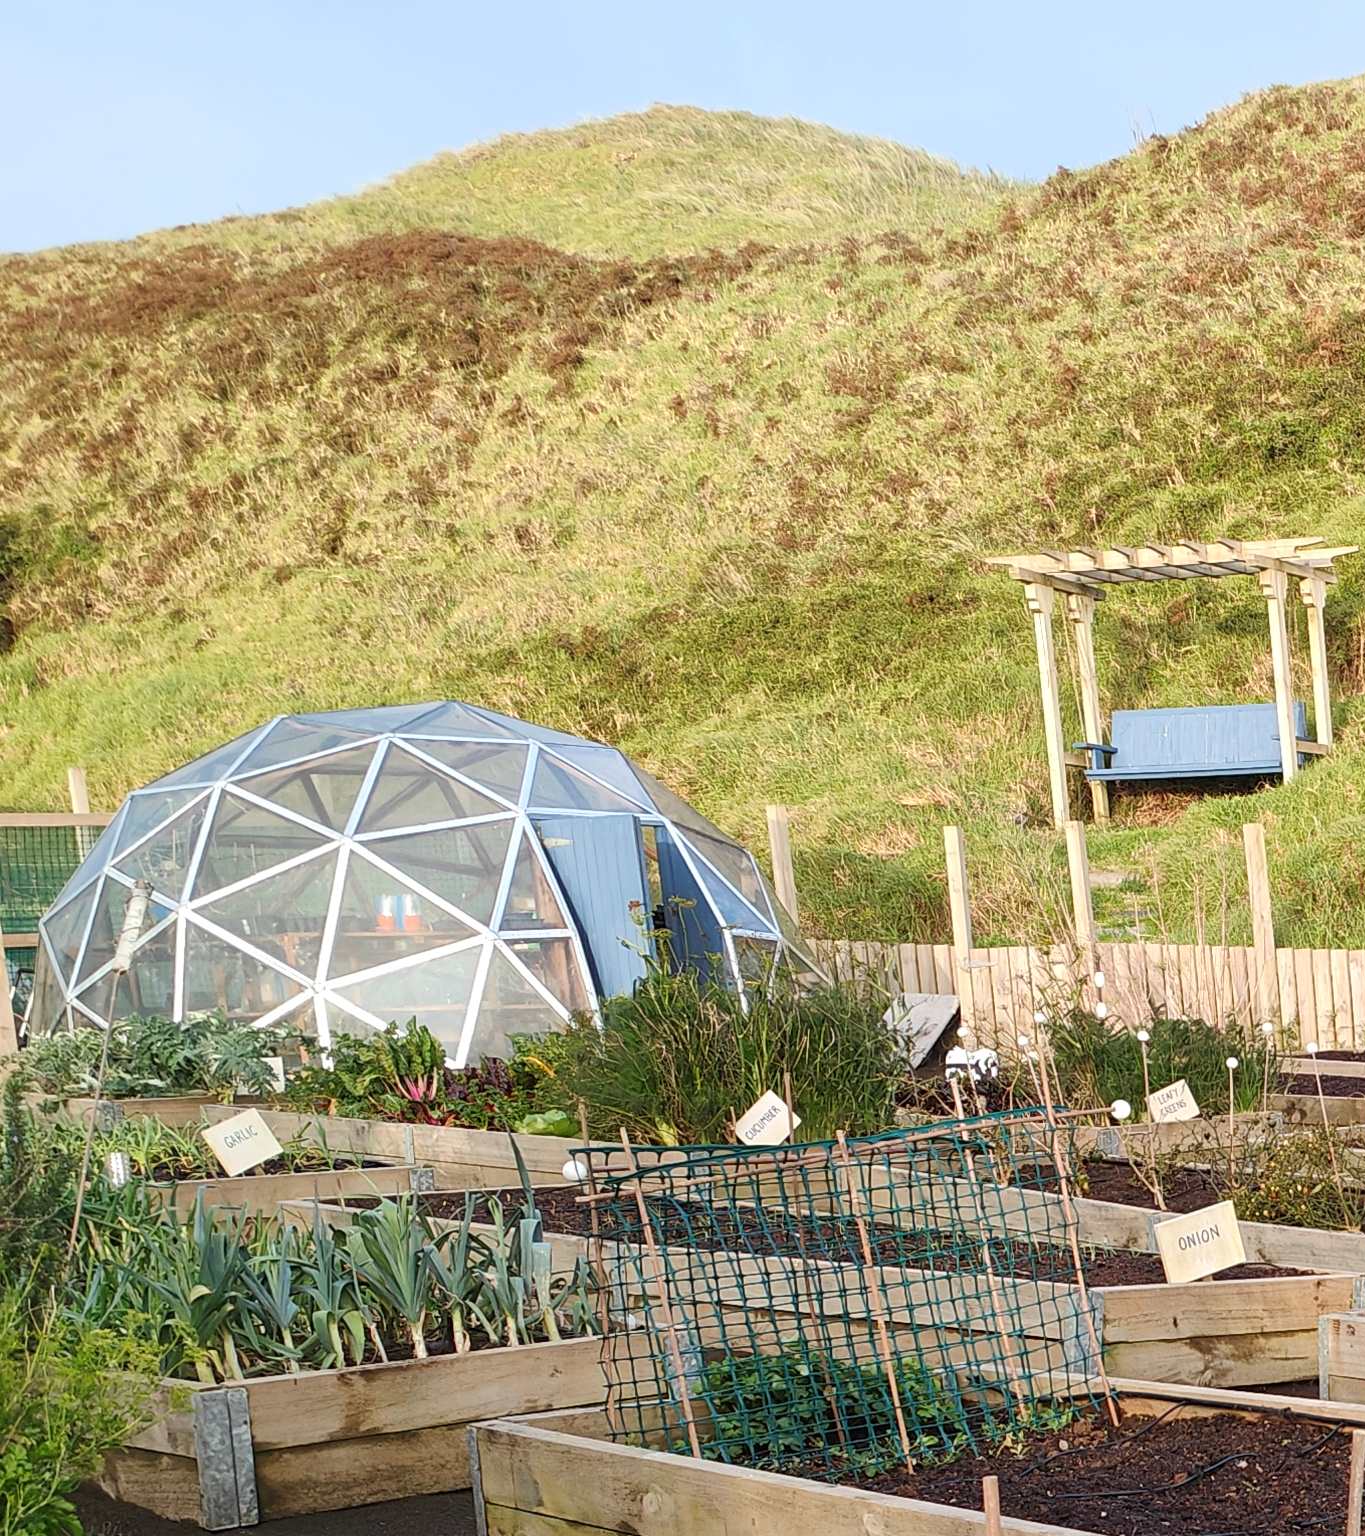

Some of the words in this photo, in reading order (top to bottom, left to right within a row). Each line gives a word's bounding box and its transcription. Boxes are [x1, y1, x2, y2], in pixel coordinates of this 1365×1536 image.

[223, 1124, 258, 1149] GARLIC
[744, 1105, 781, 1141] CUCUMBER
[1178, 1224, 1220, 1251] ONION
